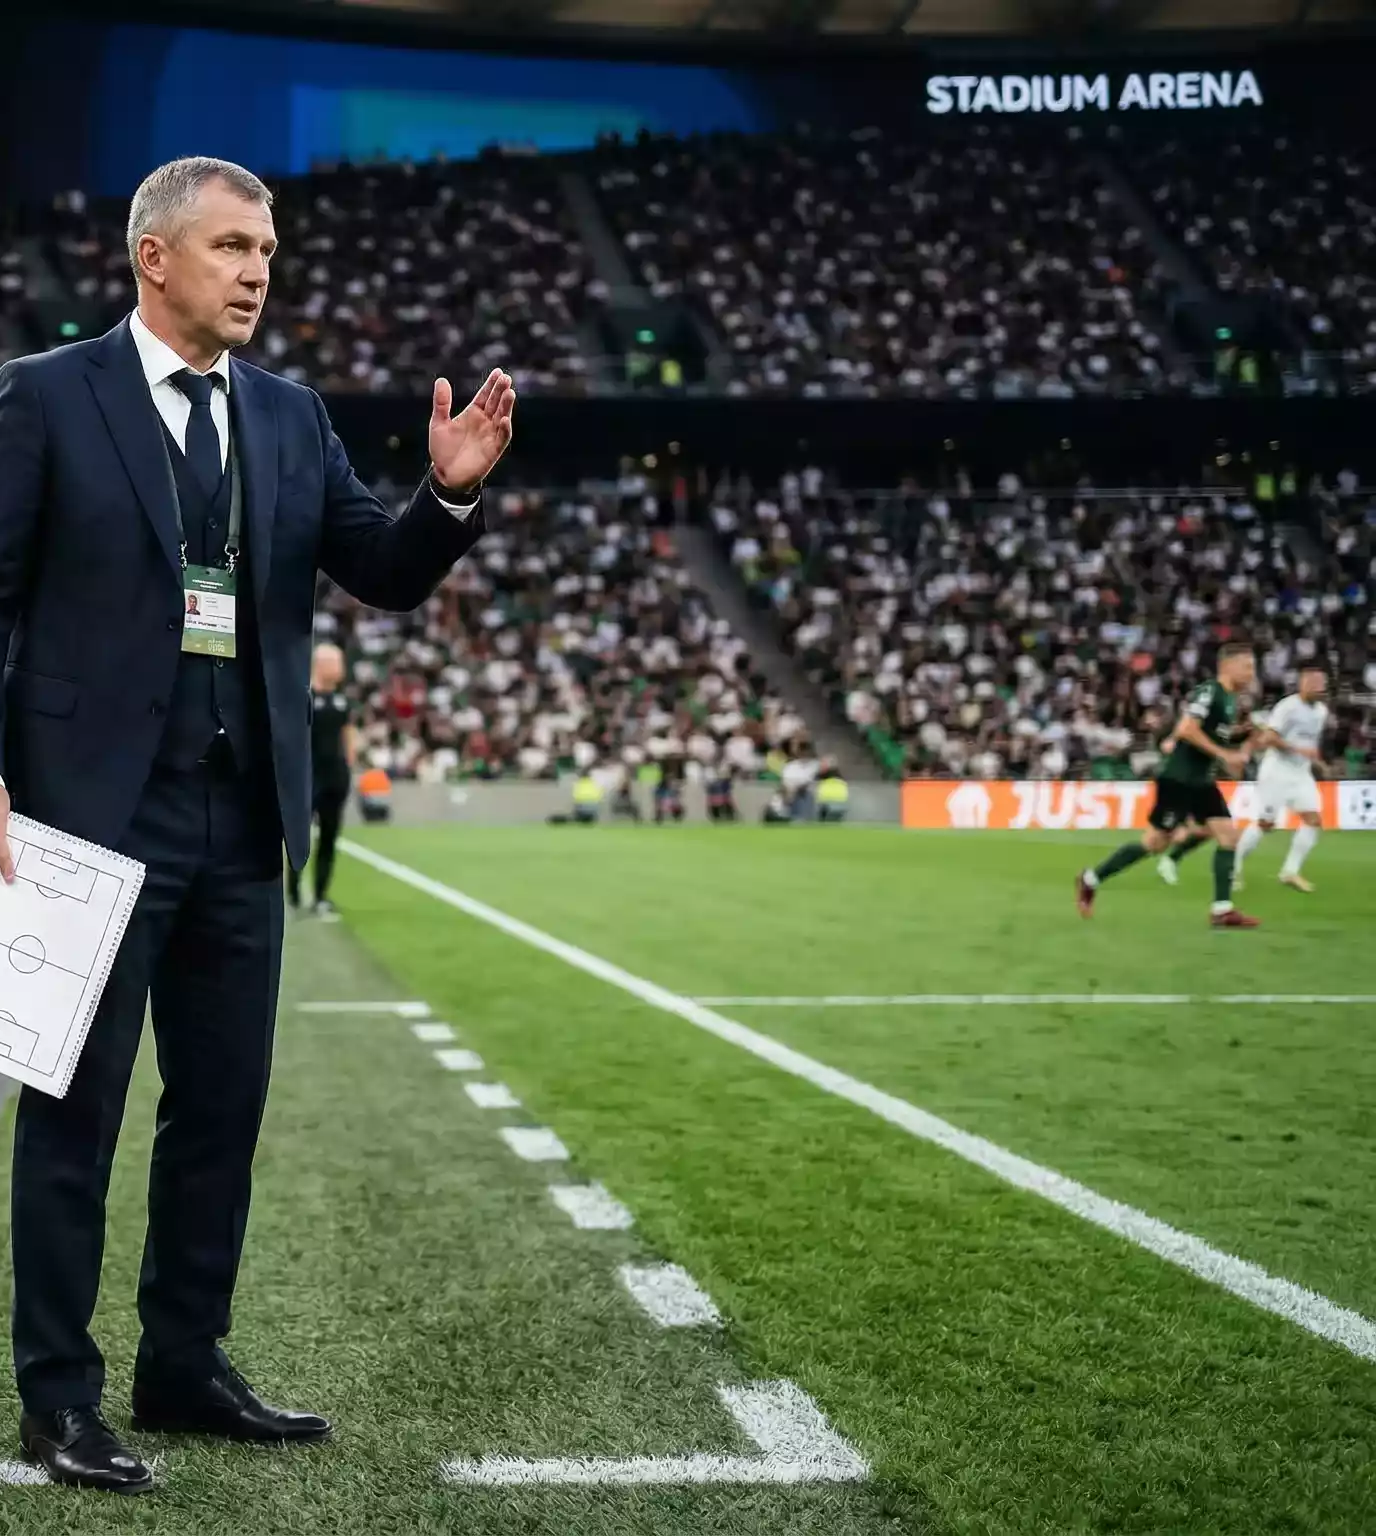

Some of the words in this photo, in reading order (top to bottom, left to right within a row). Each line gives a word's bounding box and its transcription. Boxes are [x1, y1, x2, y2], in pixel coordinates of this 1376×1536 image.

[926, 74, 1109, 114] STADIUM
[1118, 70, 1263, 110] ARENA
[1009, 781, 1149, 829] JUST
